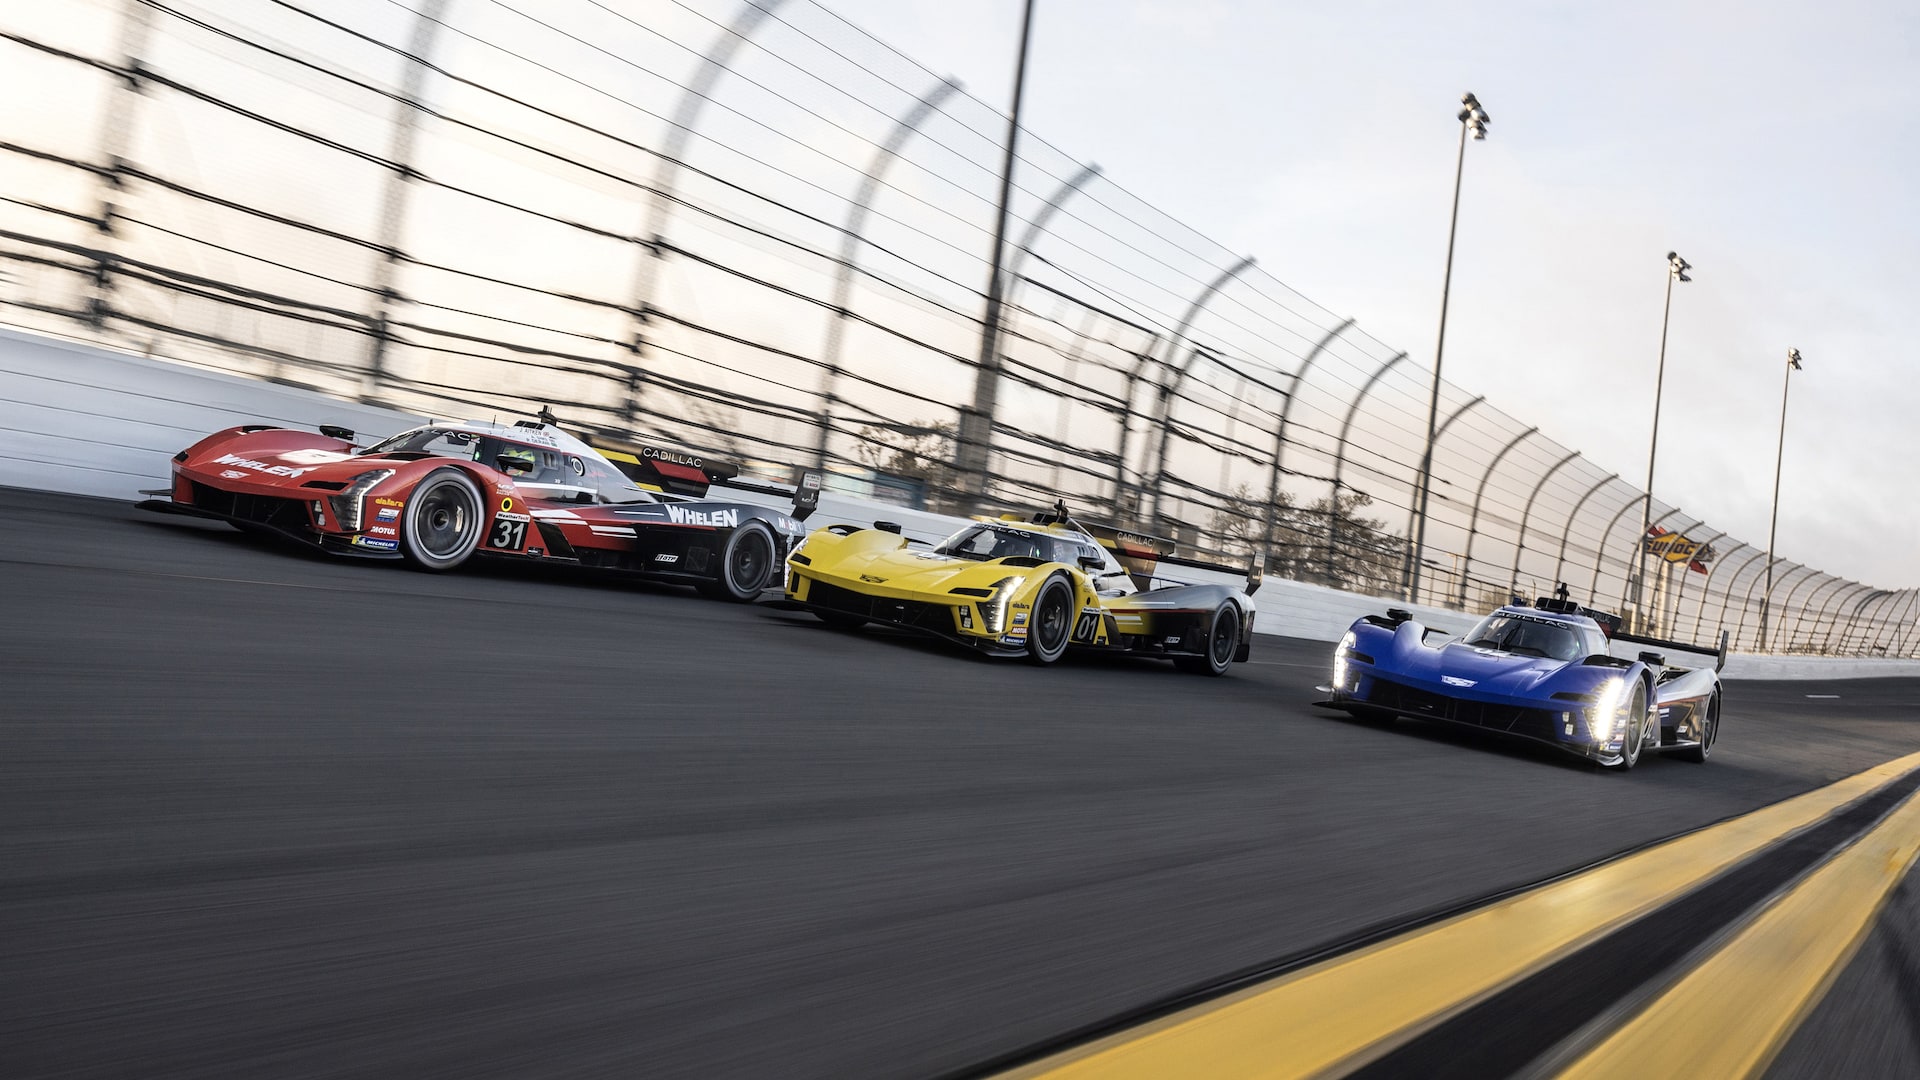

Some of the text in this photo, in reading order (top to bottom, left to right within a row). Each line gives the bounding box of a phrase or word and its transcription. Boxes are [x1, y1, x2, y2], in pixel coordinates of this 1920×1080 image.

[212, 453, 305, 479] WHELEN
[643, 447, 702, 468] CADILLAC
[664, 503, 738, 528] WHELEN
[370, 525, 396, 536] MOTUL
[493, 520, 525, 550] 31
[1117, 532, 1153, 547] CADILLAC
[366, 540, 395, 548] MICHELIN
[1077, 615, 1098, 640] 01
